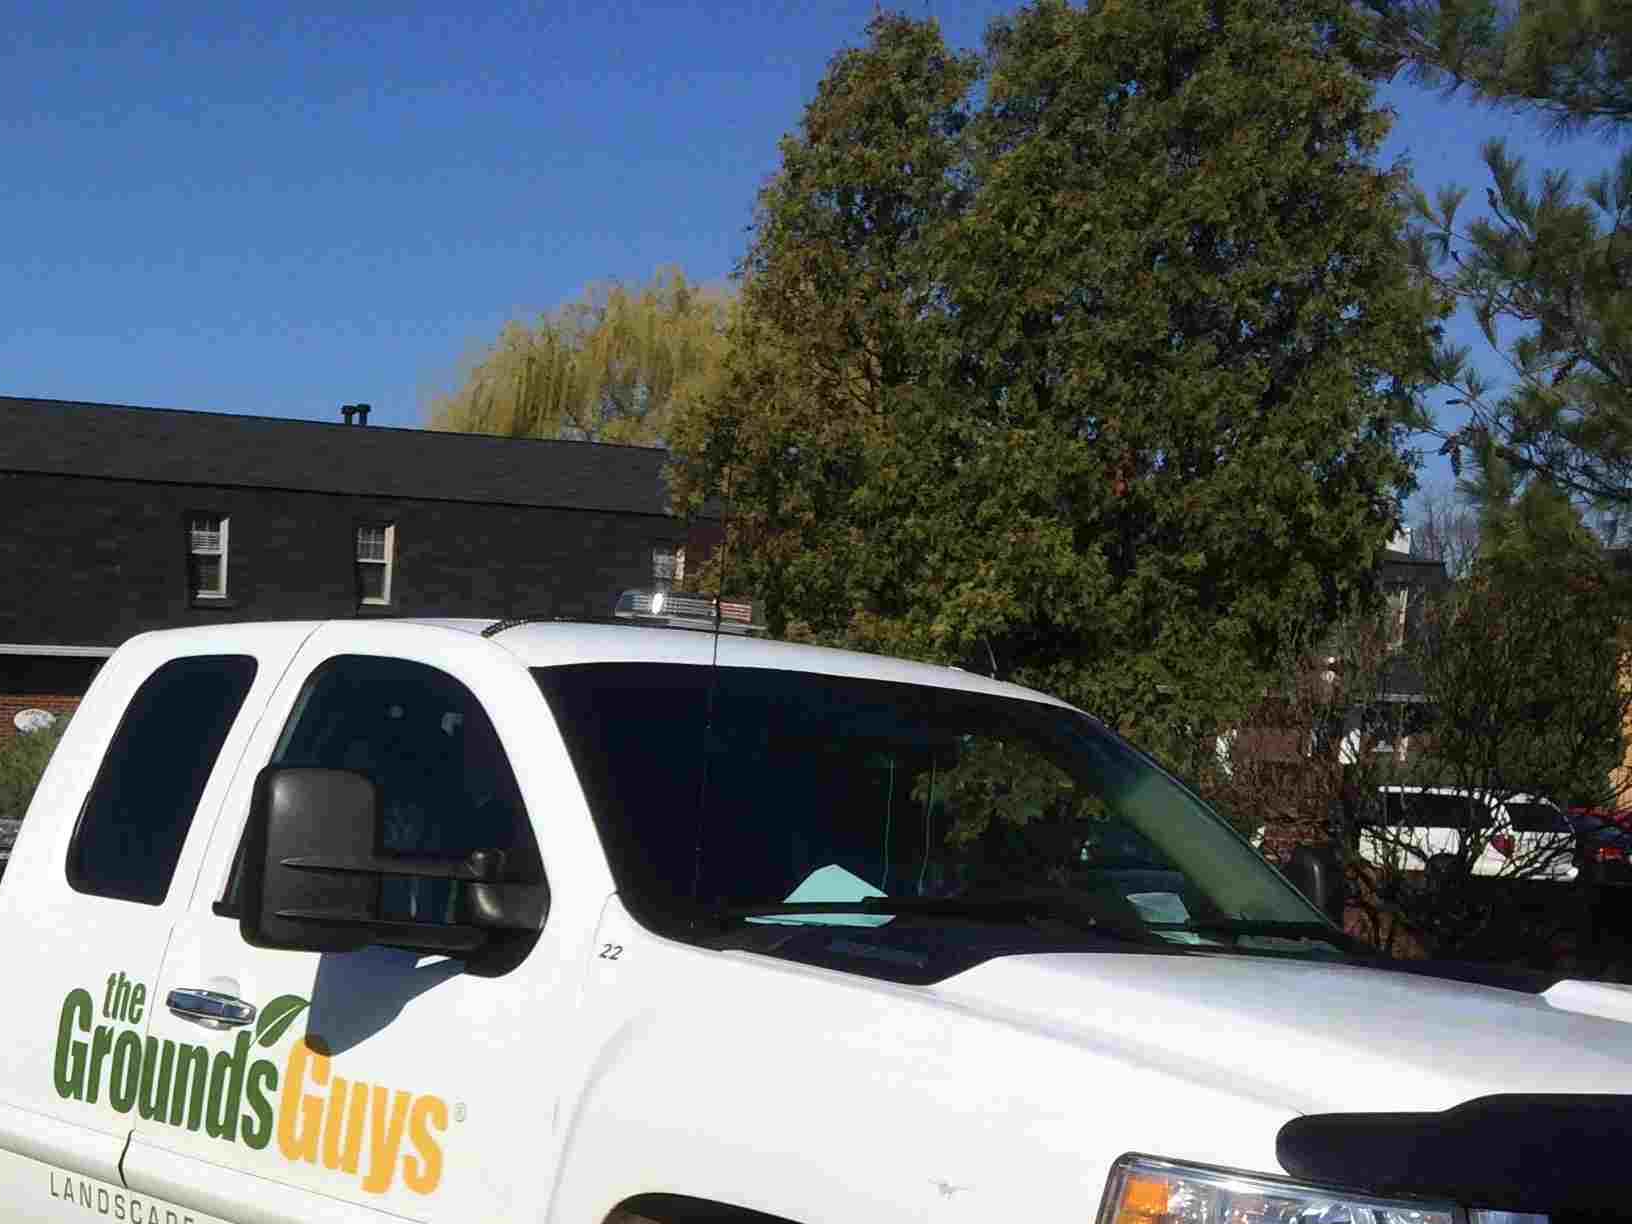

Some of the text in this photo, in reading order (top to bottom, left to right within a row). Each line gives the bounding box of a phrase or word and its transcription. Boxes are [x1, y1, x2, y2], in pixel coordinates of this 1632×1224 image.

[599, 943, 624, 961] 22
[102, 971, 147, 1025] the
[53, 988, 449, 1196] Grounds Guys
